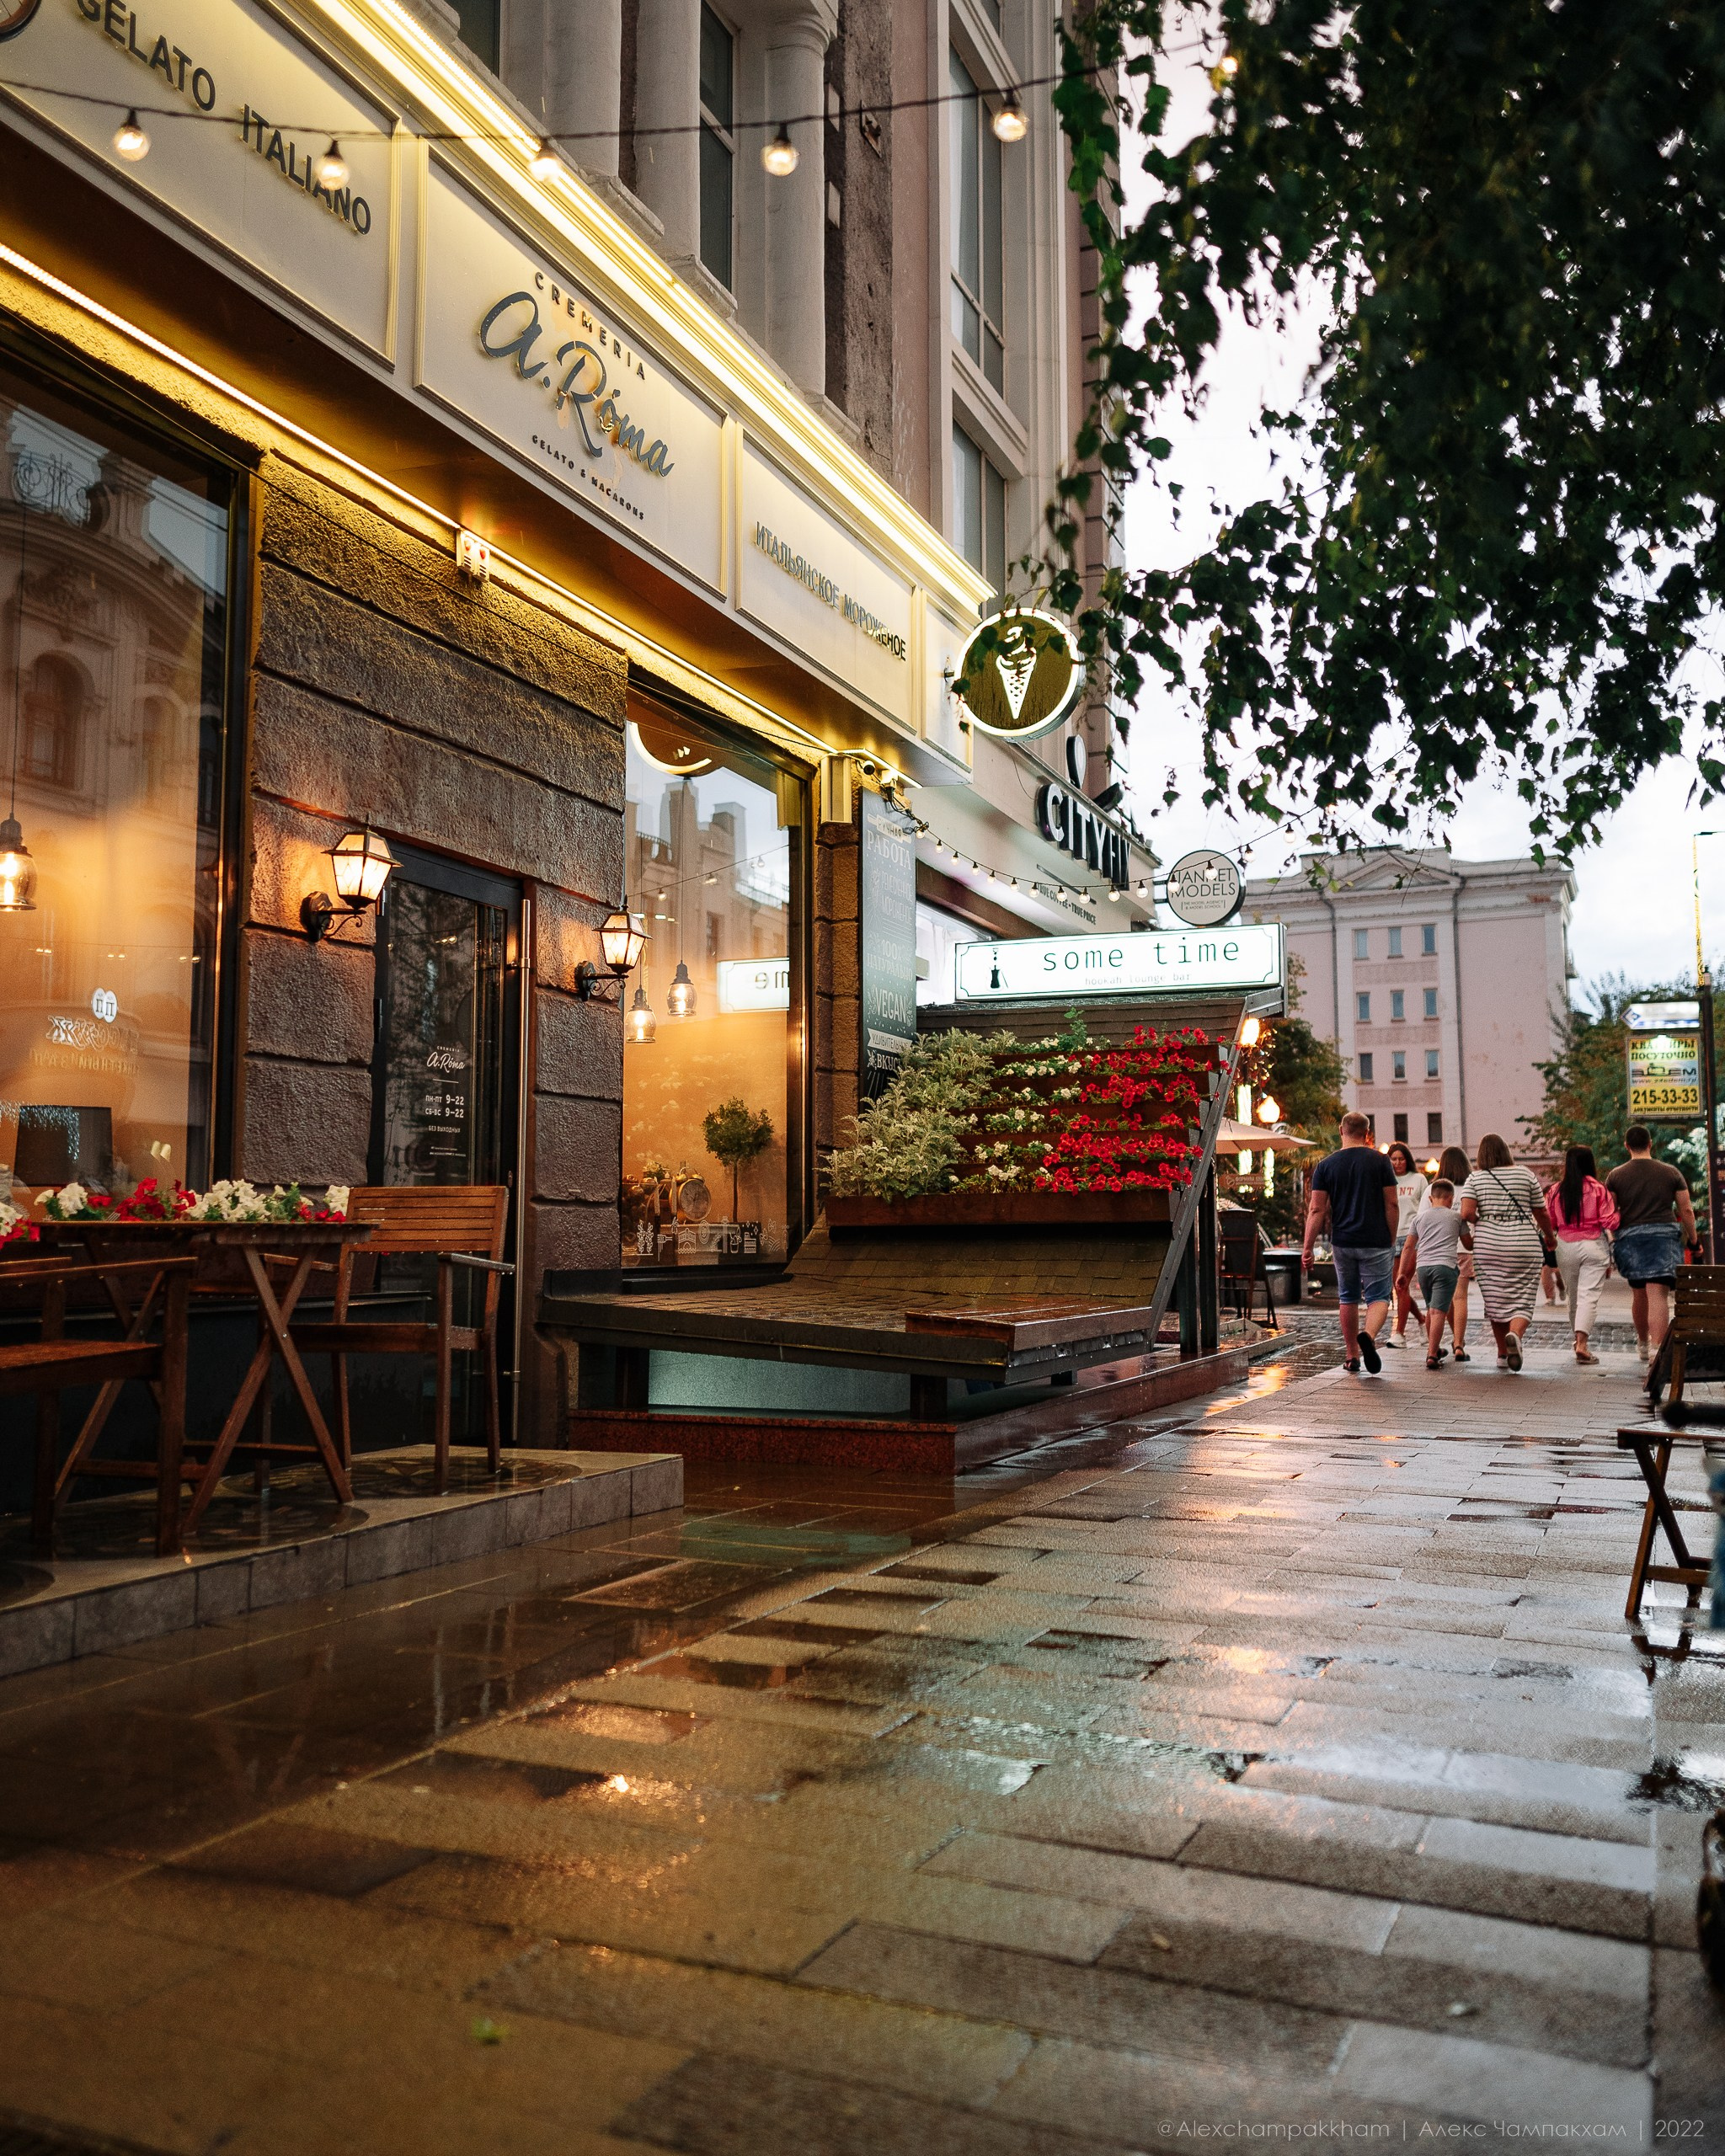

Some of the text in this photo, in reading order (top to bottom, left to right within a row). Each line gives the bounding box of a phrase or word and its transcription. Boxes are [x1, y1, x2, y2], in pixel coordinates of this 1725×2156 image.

[77, 0, 216, 111] GELATO
[535, 271, 645, 380] CREMERIA
[531, 434, 575, 470] GELATO
[591, 476, 645, 520] MACARONS
[756, 521, 906, 662] ИТАЛЬЯНСКОЕ МОРОЖЕНОЕ
[878, 817, 902, 839] РУЧНАЯ
[867, 829, 911, 871] РАБОТА
[1172, 883, 1236, 899] MODELS
[1071, 902, 1083, 918] TRUE
[1083, 910, 1097, 926] PRICE
[1043, 937, 1239, 971] some time
[1085, 973, 1190, 985] hookah lounge bar
[875, 986, 906, 1023] VEGAN
[1632, 1051, 1696, 1060] ПОСУТОЧНО
[446, 1095, 464, 1105] 9-22
[1633, 1088, 1698, 1104] 215-33-33
[425, 1107, 464, 1118] СБ-ВС 9-22
